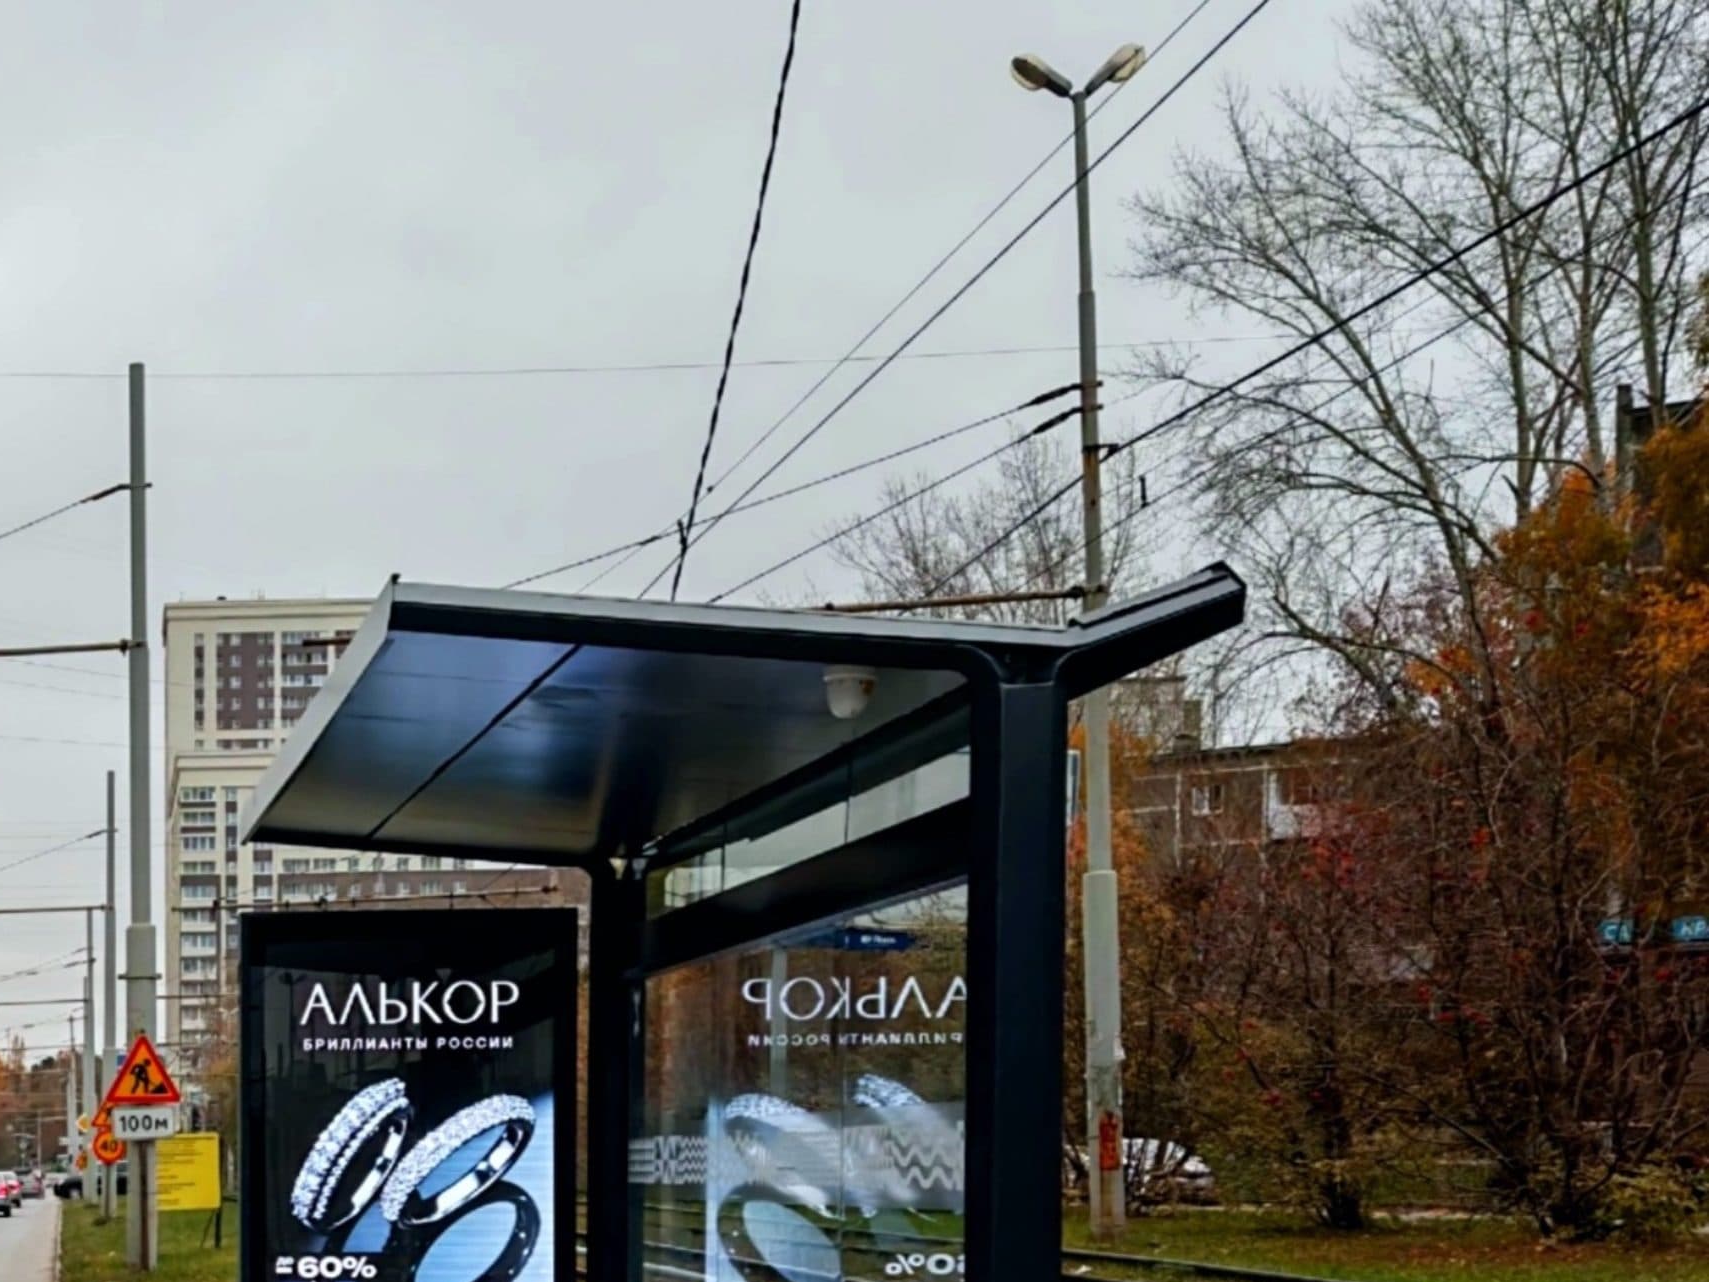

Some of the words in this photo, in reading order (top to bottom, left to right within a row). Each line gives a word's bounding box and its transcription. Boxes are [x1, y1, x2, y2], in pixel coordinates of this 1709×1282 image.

[300, 980, 520, 1025] АЛЬКОР
[303, 1037, 428, 1051] БРИЛЛИАНТЫ
[437, 1036, 514, 1049] РОССИИ
